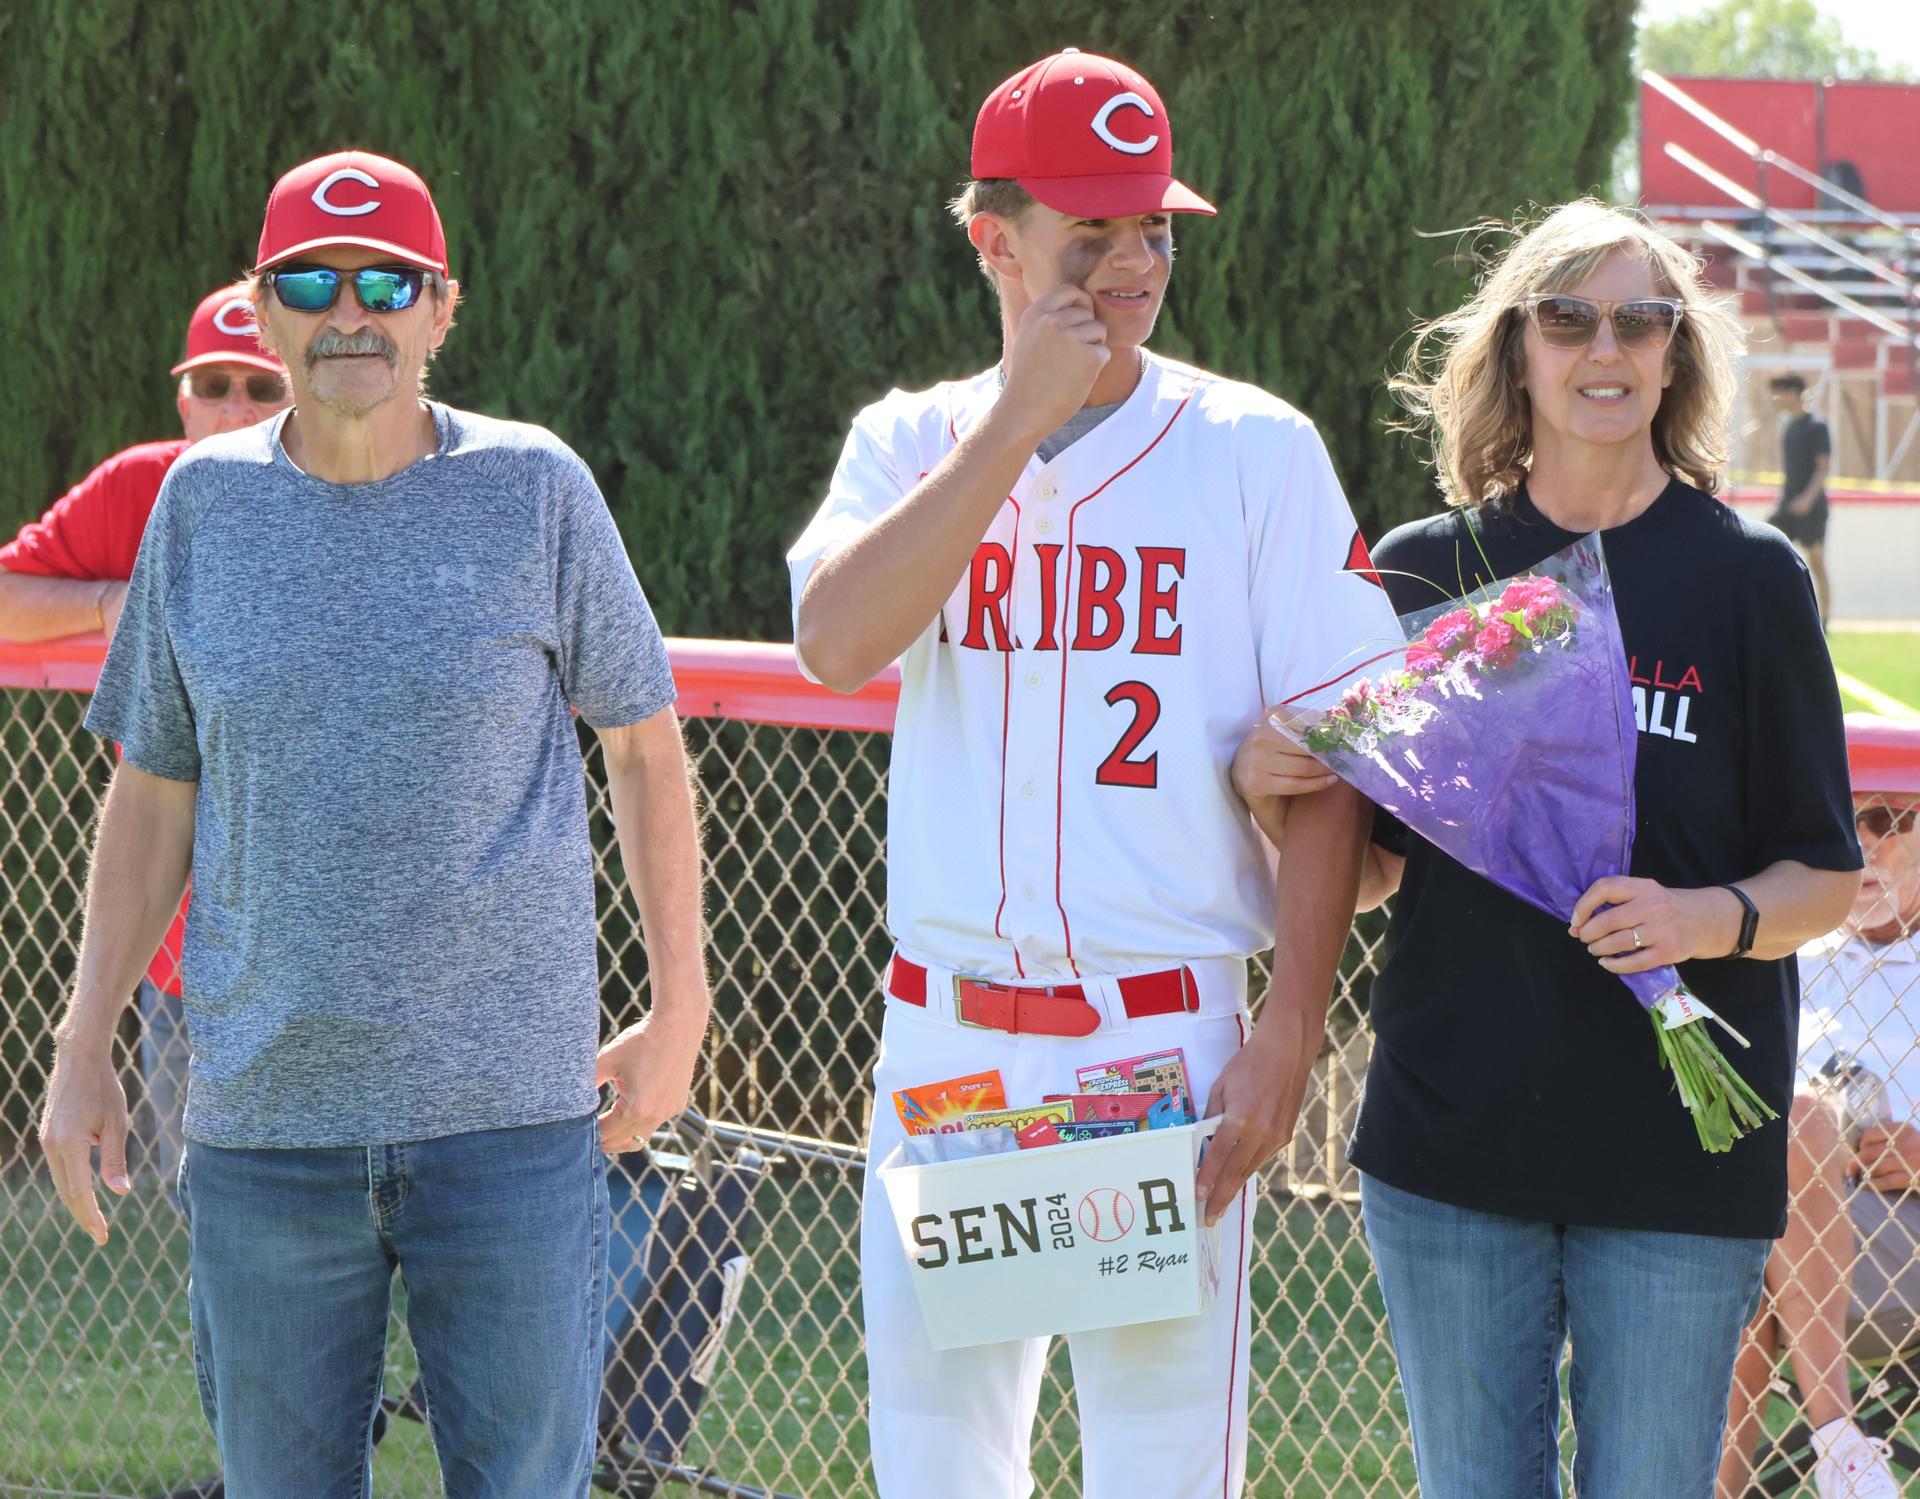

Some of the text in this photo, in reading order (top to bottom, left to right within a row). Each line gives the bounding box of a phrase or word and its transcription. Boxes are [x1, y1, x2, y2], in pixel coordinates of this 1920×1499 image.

[1091, 92, 1159, 155] C
[311, 167, 381, 216] C
[940, 542, 1186, 656] RIBE
[1095, 680, 1161, 789] 2
[960, 1082, 980, 1092] Share
[1101, 1079, 1129, 1091] EXPRESS
[1045, 1192, 1075, 1250] 2024
[1098, 1250, 1190, 1277] #2 Ryan
